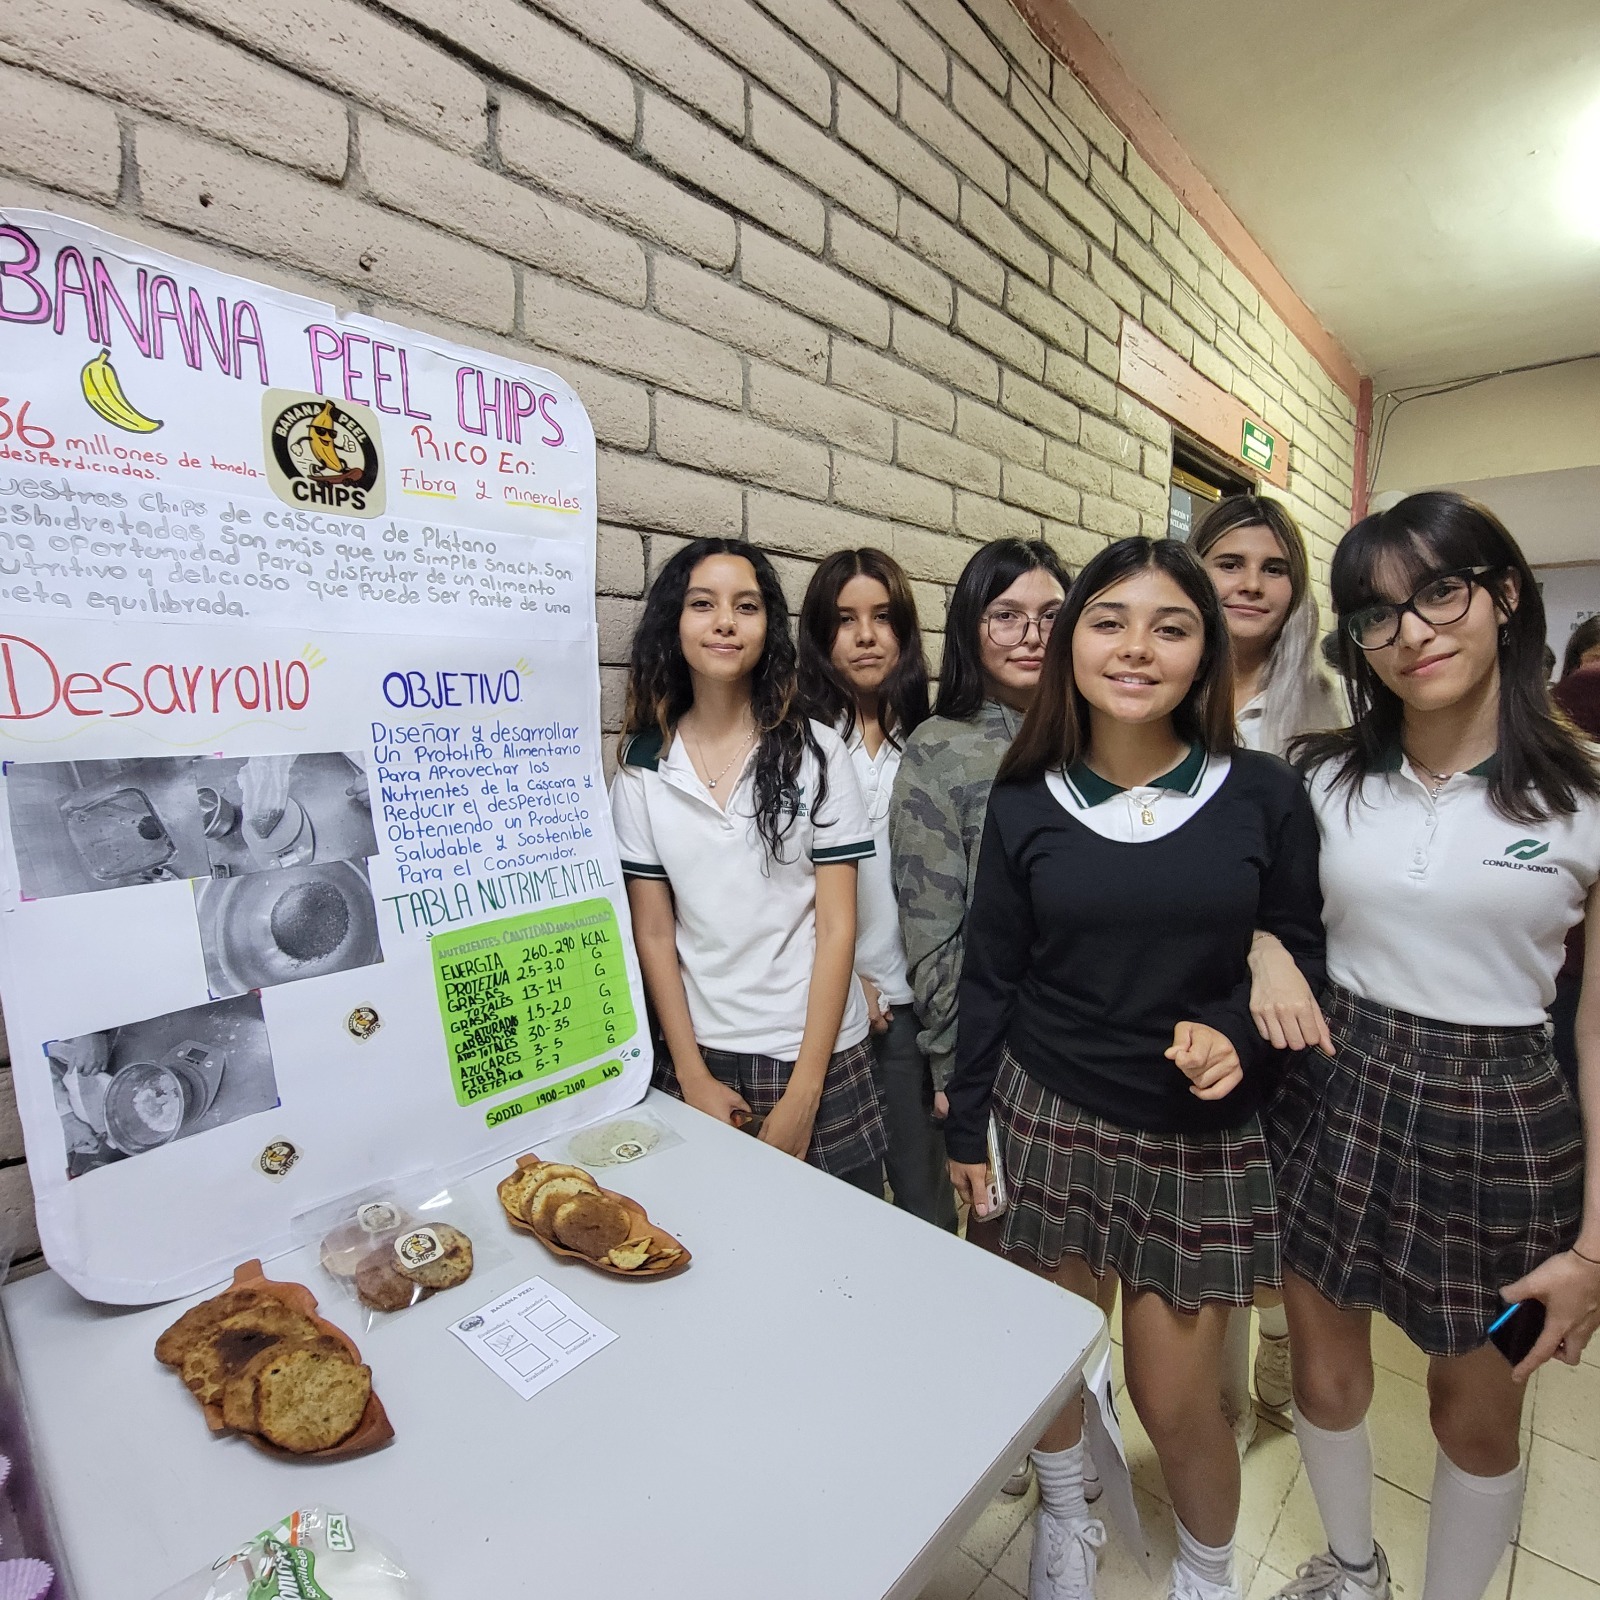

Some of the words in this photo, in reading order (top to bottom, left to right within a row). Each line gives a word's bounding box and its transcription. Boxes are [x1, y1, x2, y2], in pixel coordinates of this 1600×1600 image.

[0, 223, 269, 386] BANANA
[305, 324, 431, 420] PEEL
[275, 404, 322, 437] BANANA
[338, 413, 369, 444] PEEL
[66, 434, 168, 466] millones
[179, 452, 202, 469] de
[292, 481, 367, 511] CHIPS
[476, 478, 492, 500] y
[219, 501, 252, 524] de
[382, 521, 409, 543] de
[335, 544, 376, 563] que
[383, 549, 407, 562] un
[138, 568, 153, 587] y
[168, 561, 290, 591] delicioso
[306, 580, 349, 601] que
[519, 595, 538, 611] de
[545, 602, 571, 614] una
[426, 566, 447, 585] de
[453, 574, 475, 587] un
[479, 574, 556, 596] alimento
[86, 588, 250, 617] equilibrada.
[0, 633, 310, 720] Desarrollo
[371, 721, 461, 745] Diseñar
[472, 724, 484, 743] y
[490, 719, 580, 744] desarrollar
[374, 746, 401, 765] Un
[503, 742, 582, 759] Alimentario
[378, 766, 422, 784] Para
[529, 760, 550, 774] los
[381, 781, 470, 803] Nutrientes
[481, 779, 499, 796] de
[507, 778, 519, 793] la
[583, 774, 594, 790] y
[383, 801, 456, 823] Reducir
[463, 798, 479, 816] el
[388, 815, 494, 842] Obteniendo
[504, 815, 523, 829] un
[528, 806, 590, 828] Producto
[395, 837, 483, 864] Saludable
[496, 833, 508, 852] y
[453, 859, 472, 877] el
[382, 881, 474, 935] TABLA
[476, 858, 616, 914] NUTRIMENTAL
[441, 952, 504, 981] ENERGIA
[444, 969, 511, 1000] PROTEINA
[591, 946, 603, 960] G
[447, 988, 505, 1013] GRASAS
[594, 963, 606, 977] G
[464, 996, 514, 1018] TOTALES
[599, 983, 612, 998] G
[450, 1011, 499, 1034] GRASAS
[602, 1002, 615, 1016] G
[362, 1022, 381, 1040] CHIPS
[604, 1019, 616, 1032] G
[460, 1051, 522, 1080] AZUCARES
[462, 1068, 506, 1092] FIBRA
[486, 1103, 523, 1127] SODIO
[279, 1153, 300, 1176] CHIPS
[411, 1251, 436, 1265] CHIPS
[490, 1296, 519, 1314] BANANA
[518, 1286, 535, 1298] PEEL
[329, 1518, 344, 1549] 125
